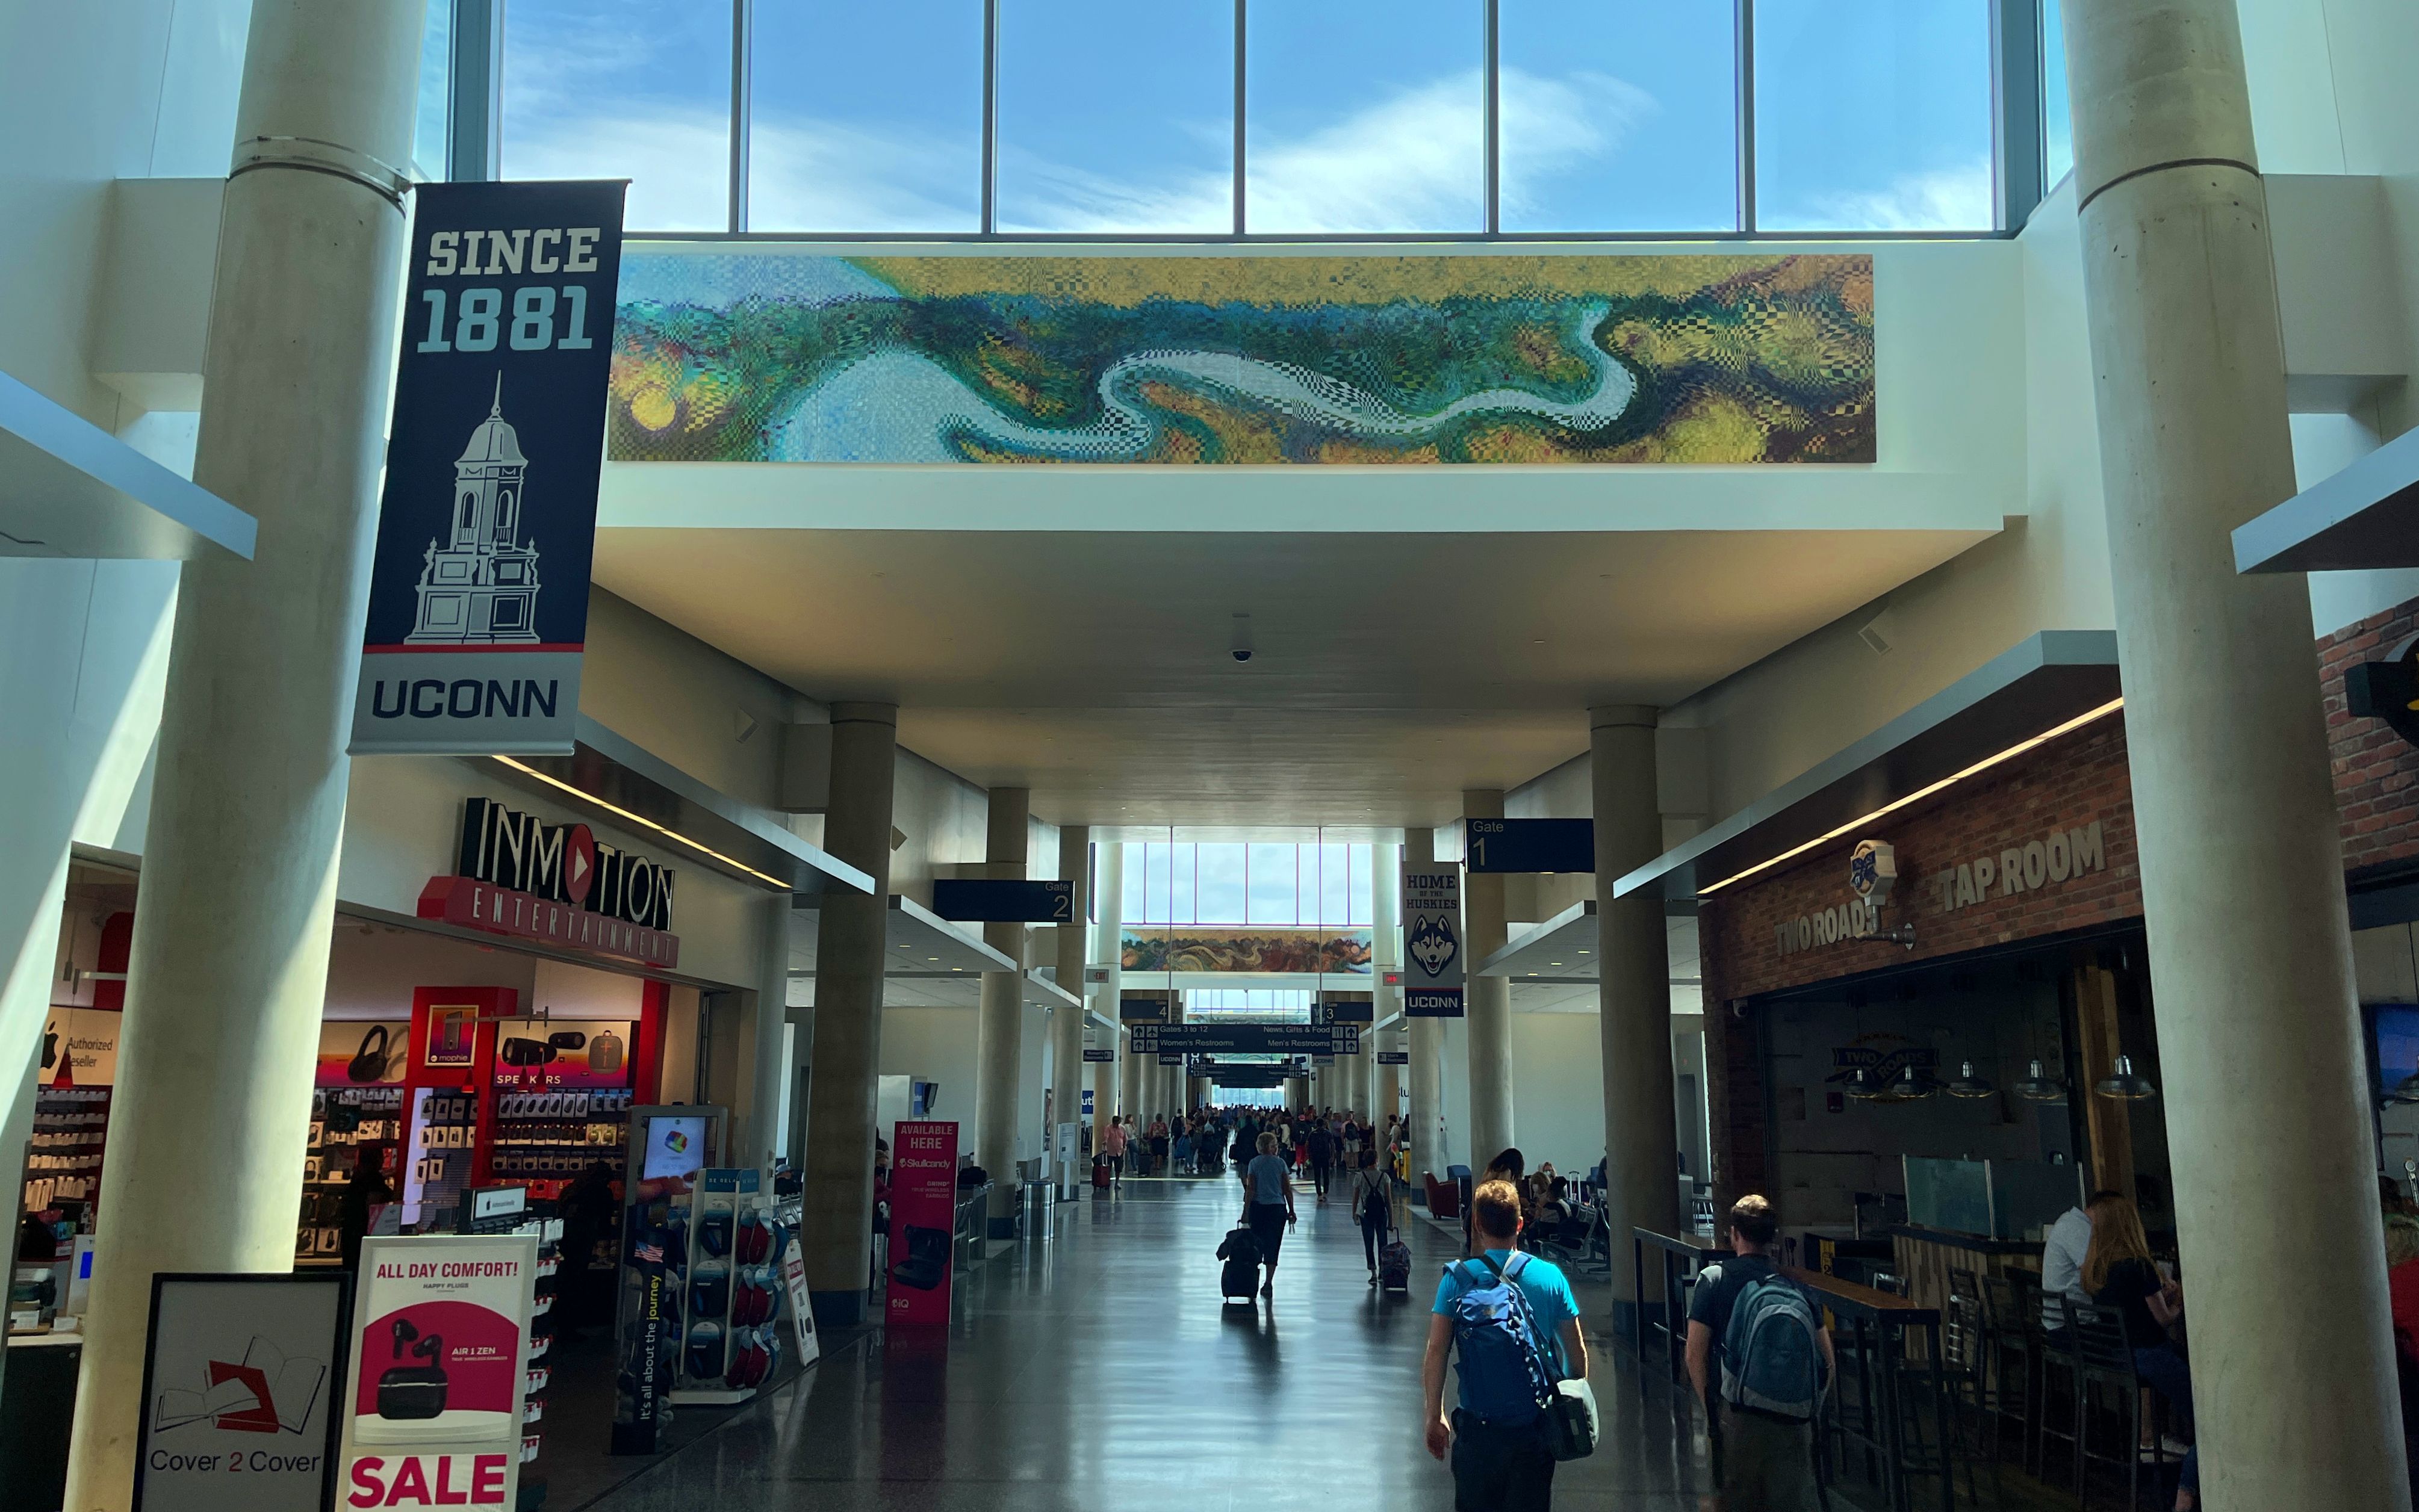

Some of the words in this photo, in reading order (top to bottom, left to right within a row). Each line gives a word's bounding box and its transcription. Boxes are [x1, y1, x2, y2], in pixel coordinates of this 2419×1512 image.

[427, 228, 600, 276] SINCE
[417, 285, 592, 353] 1881
[372, 679, 559, 719] UCONN
[1473, 820, 1504, 832] Gate
[1473, 837, 1485, 866] 1
[1938, 857, 1996, 912] TAP
[2001, 820, 2106, 896] ROOM
[1045, 882, 1069, 891] Gate
[1406, 875, 1456, 888] HOME
[1053, 895, 1069, 917] 2
[1406, 899, 1457, 909] HUSKIES
[473, 887, 672, 961] ENTERTAINMENT
[1774, 916, 1812, 956] TWO
[1408, 996, 1458, 1008] UCONN
[1159, 1006, 1167, 1018] 4
[1326, 1008, 1334, 1019] 3
[68, 1037, 113, 1050] Authorized
[71, 1055, 97, 1067] eseller
[1845, 1051, 1878, 1063] TWO
[497, 1075, 561, 1084] SPEKRS
[901, 1125, 953, 1135] AVAILABLE
[910, 1138, 942, 1149] HERE
[907, 1159, 951, 1170] Skullcandy
[377, 1263, 405, 1278] ALL
[410, 1263, 438, 1278] DAY
[442, 1262, 518, 1277] COMFORT!
[647, 1274, 662, 1321] journey
[644, 1322, 656, 1343] the
[642, 1347, 654, 1383] about
[641, 1386, 652, 1399] all
[640, 1400, 651, 1419] It's
[150, 1450, 220, 1473] Cover
[228, 1452, 242, 1472] 2
[249, 1451, 321, 1473] Cover
[348, 1454, 507, 1508] SALE
